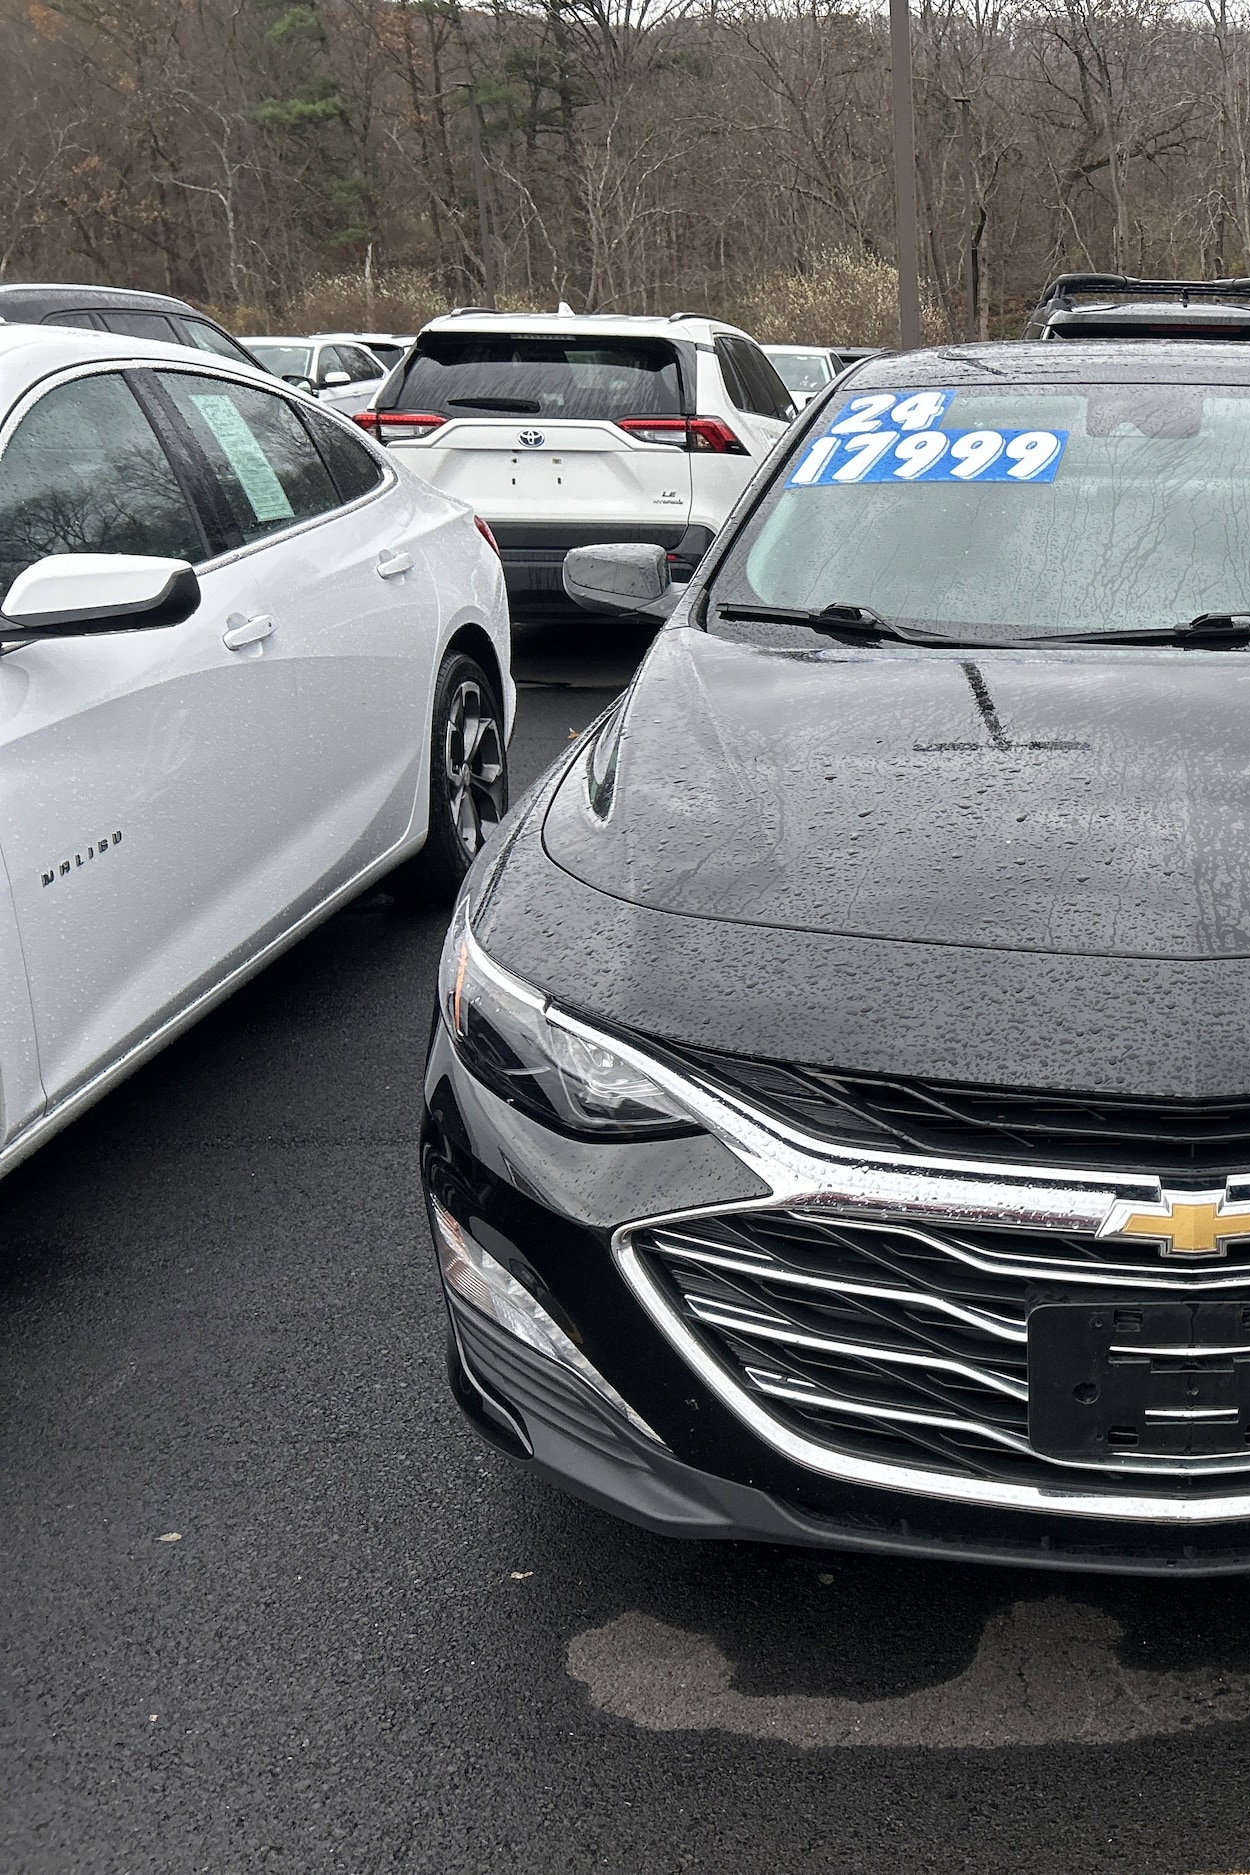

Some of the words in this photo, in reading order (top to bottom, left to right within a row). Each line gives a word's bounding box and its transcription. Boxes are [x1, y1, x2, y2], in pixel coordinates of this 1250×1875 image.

[832, 391, 946, 434] 24
[791, 430, 1060, 484] 17999
[41, 830, 122, 888] MALIBU
